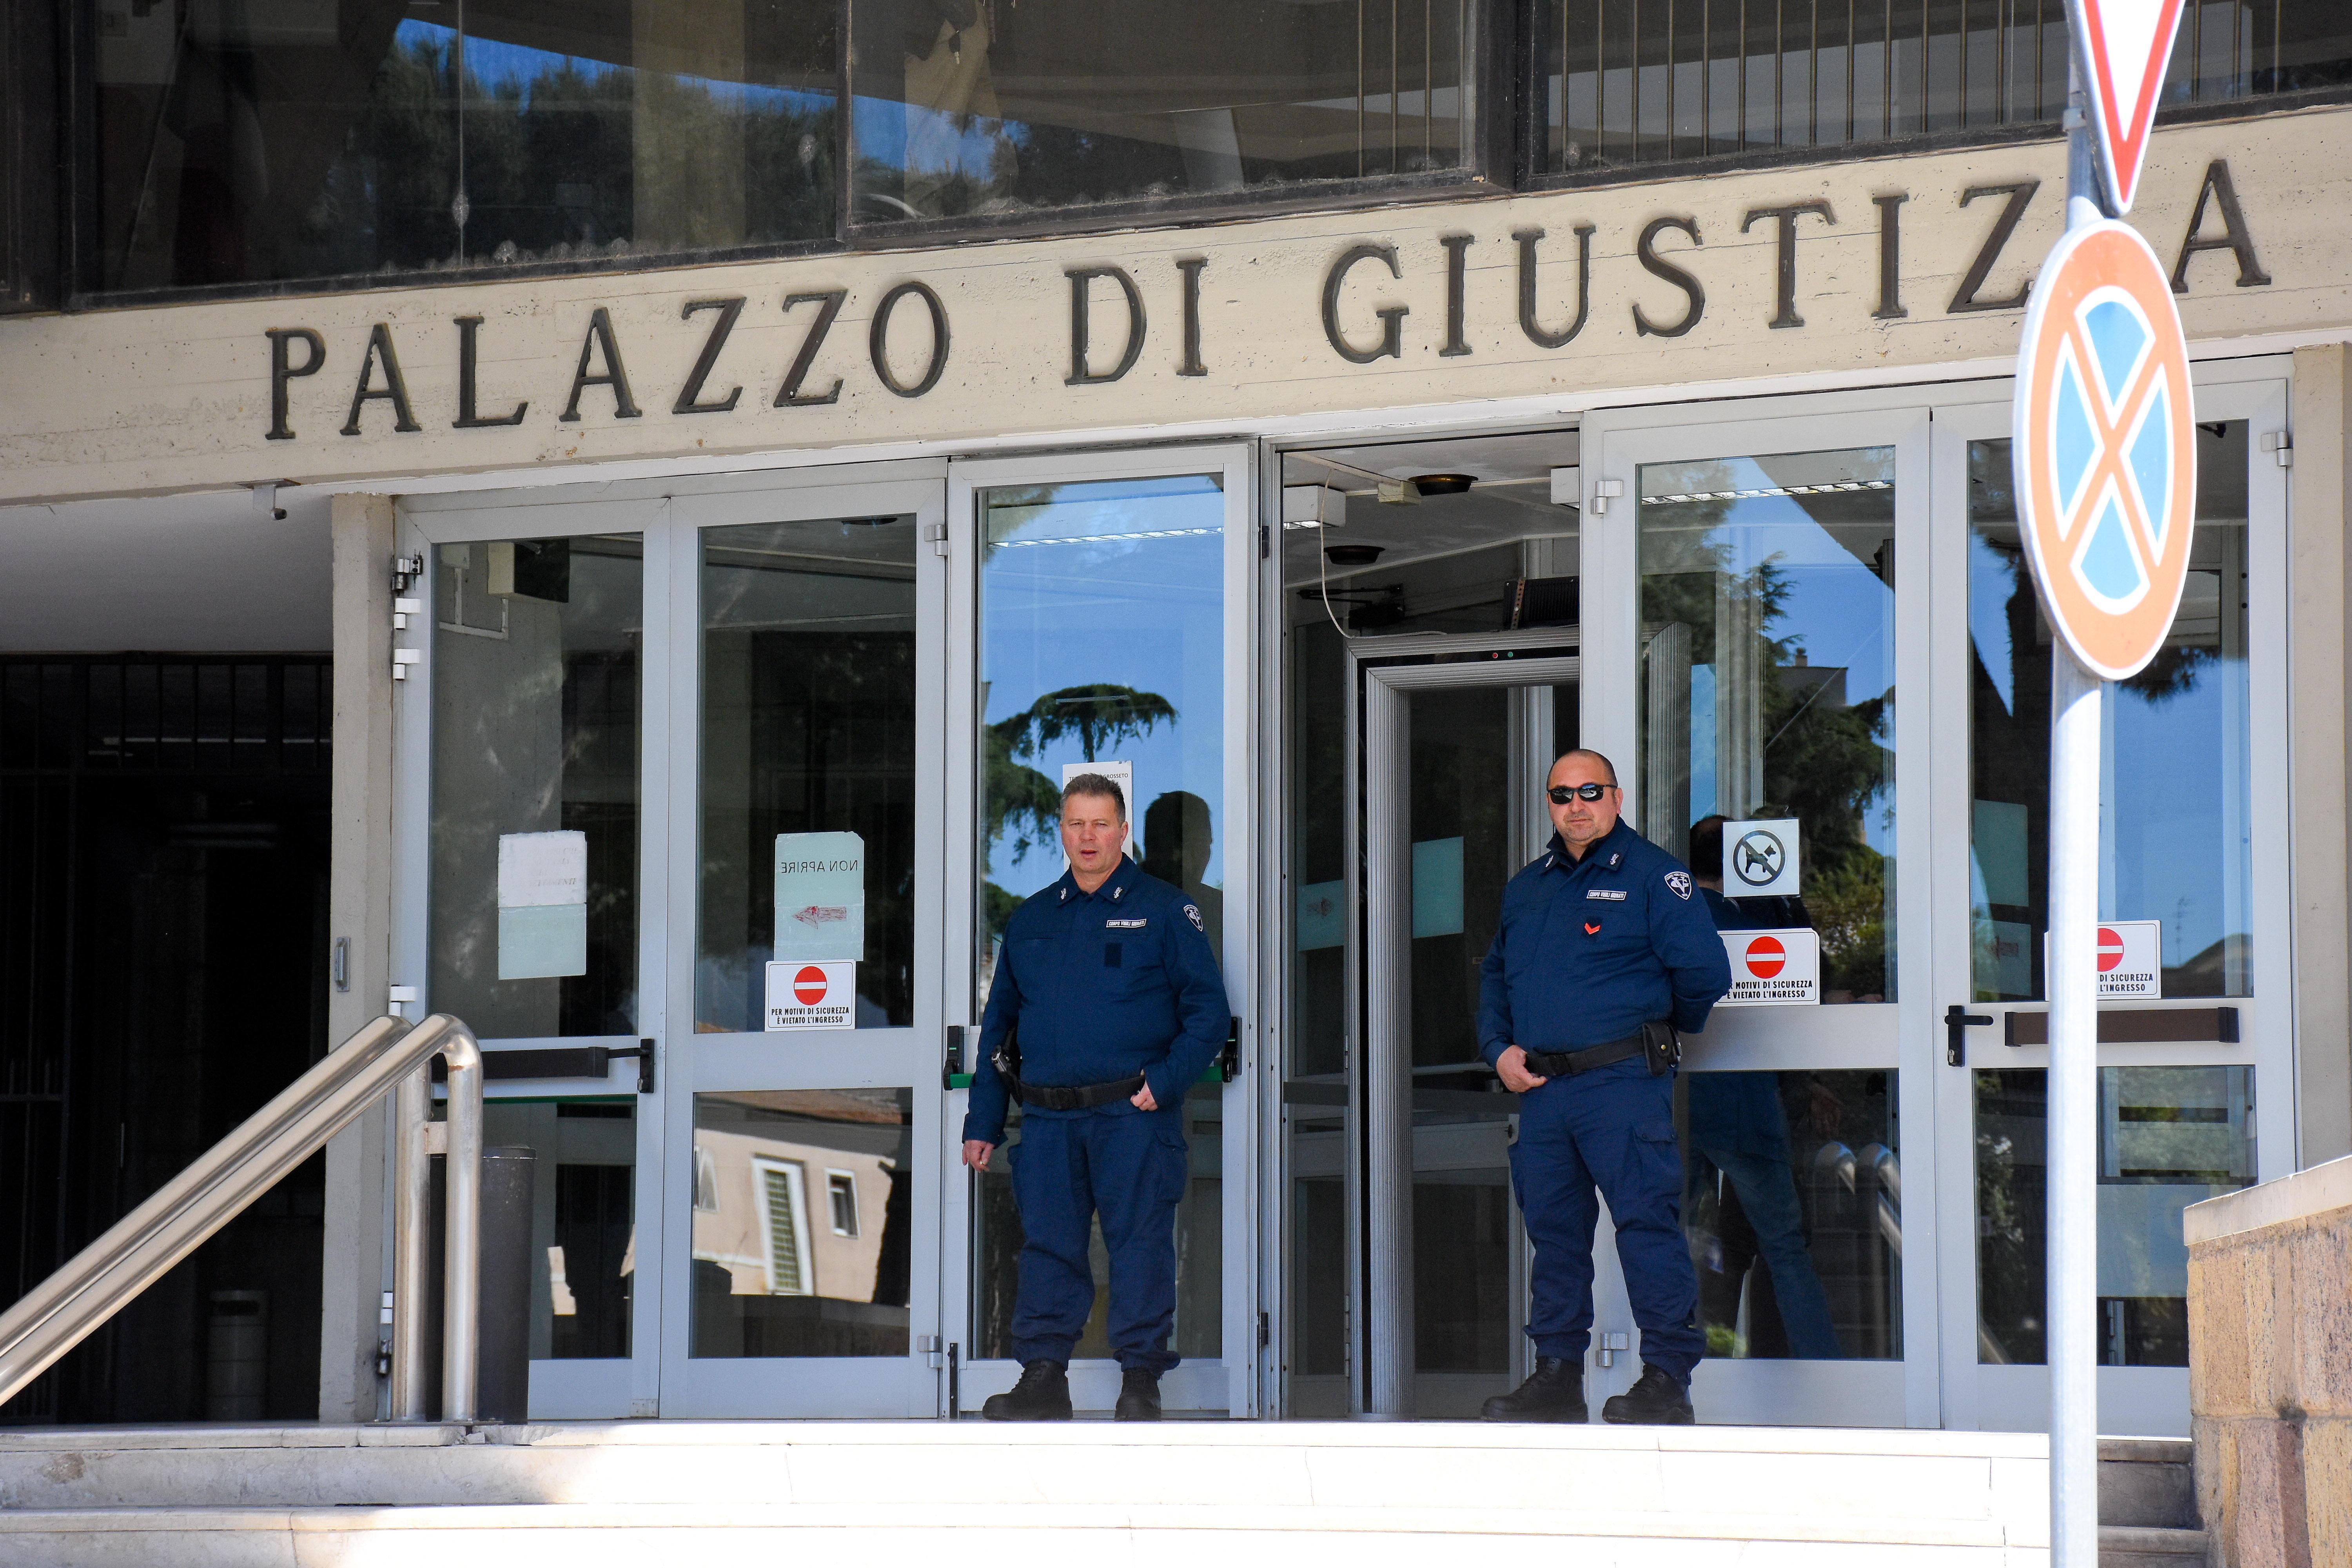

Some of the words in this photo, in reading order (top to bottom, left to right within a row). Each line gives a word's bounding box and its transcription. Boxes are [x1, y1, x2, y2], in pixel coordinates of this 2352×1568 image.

[264, 279, 950, 440] PALAZZO
[1063, 257, 1210, 387] DI
[1321, 158, 2272, 365] GIUSTIZA
[2111, 973, 2153, 982] SICUREZZA
[1736, 981, 1760, 989] MOTIVI
[1763, 990, 1806, 998] L'INGRESSO
[771, 1007, 782, 1016] PER
[784, 1007, 806, 1016] MOTIVI
[808, 1007, 814, 1015] DI
[816, 1006, 849, 1014] SICUREZZA
[777, 1015, 780, 1024] È
[782, 1016, 806, 1024] VIETATO
[808, 1015, 843, 1024] L'INGRESSO
